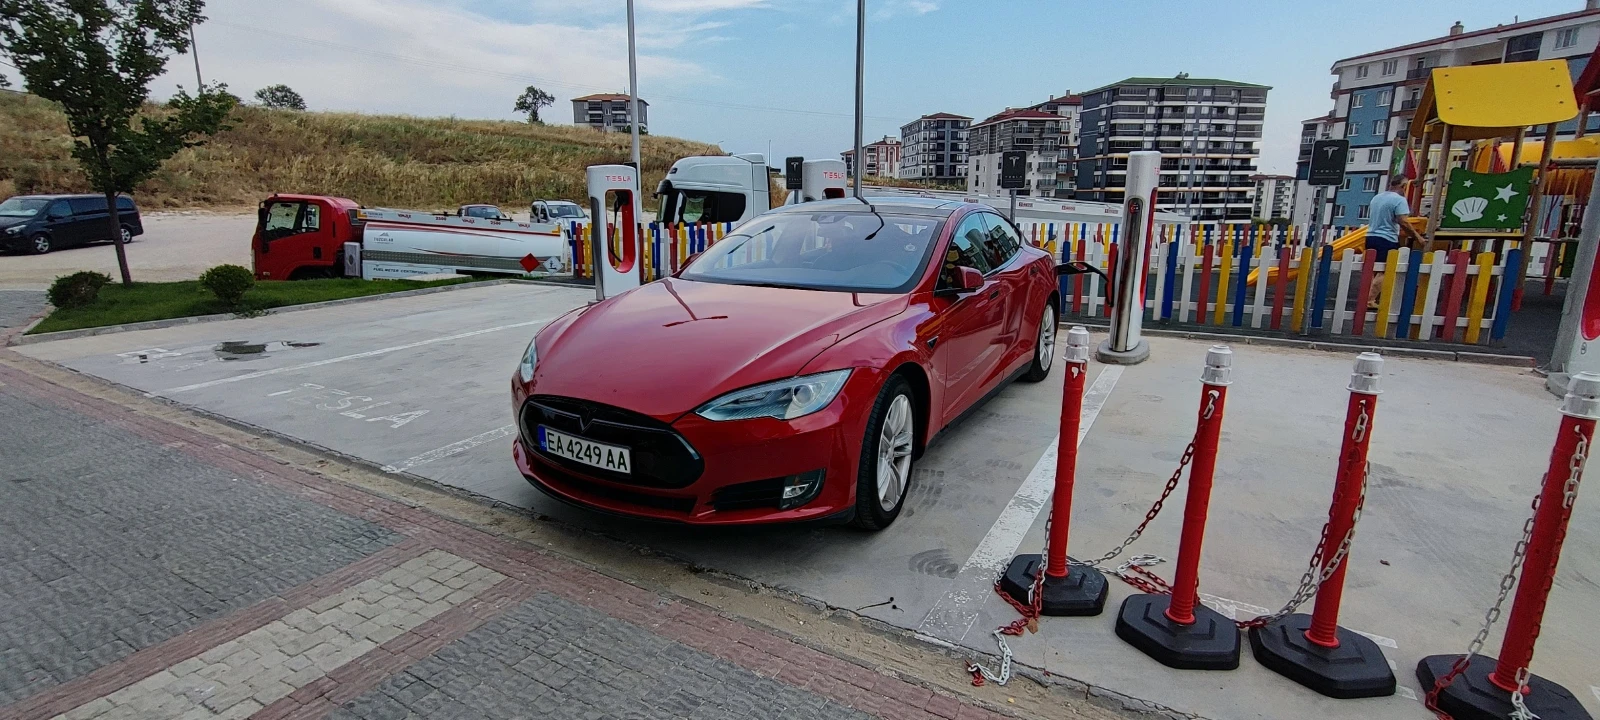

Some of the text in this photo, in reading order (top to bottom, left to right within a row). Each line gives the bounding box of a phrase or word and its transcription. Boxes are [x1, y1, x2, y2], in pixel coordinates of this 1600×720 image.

[823, 171, 844, 179] TESLA
[547, 431, 628, 471] EA 4249 AA
